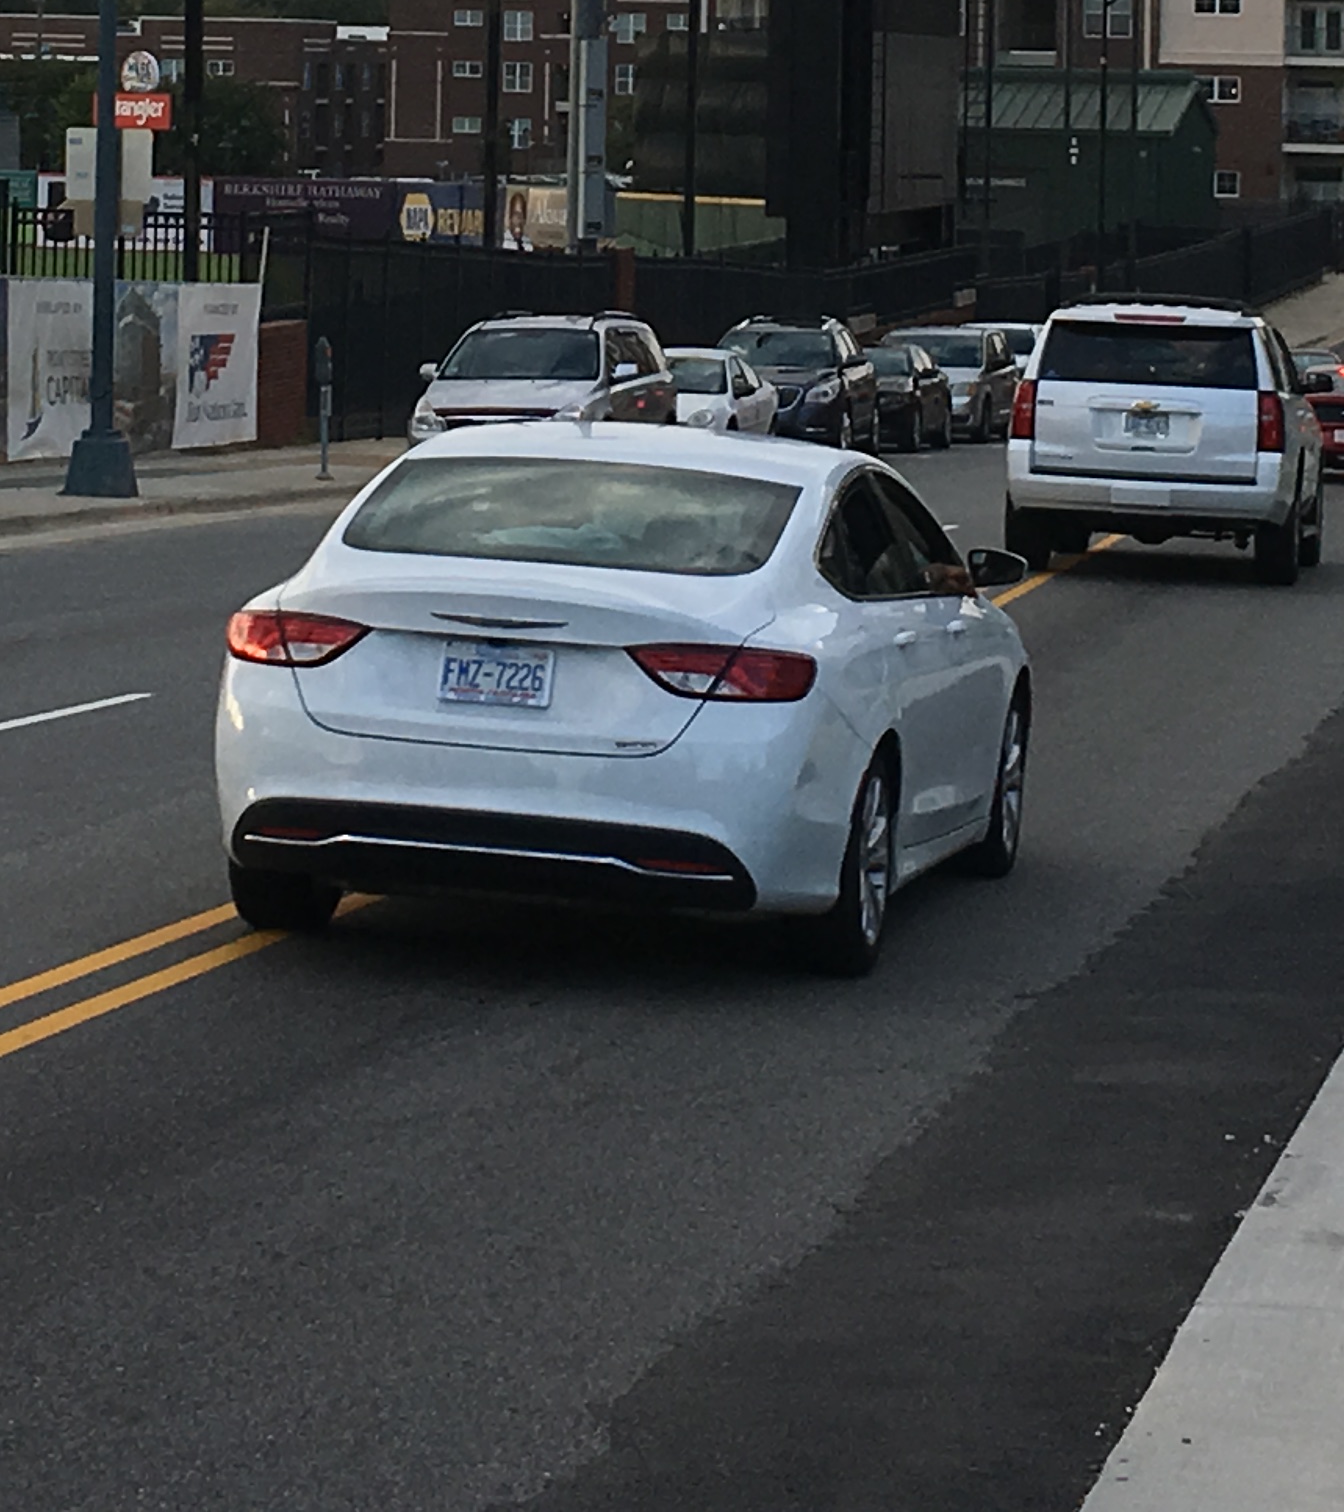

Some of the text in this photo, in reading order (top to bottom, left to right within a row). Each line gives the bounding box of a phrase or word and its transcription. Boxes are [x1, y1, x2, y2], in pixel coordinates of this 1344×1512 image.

[114, 98, 165, 126] rangler
[223, 183, 384, 199] BERKSHIRE HATHAWAY
[441, 656, 546, 692] FMZ-7226
